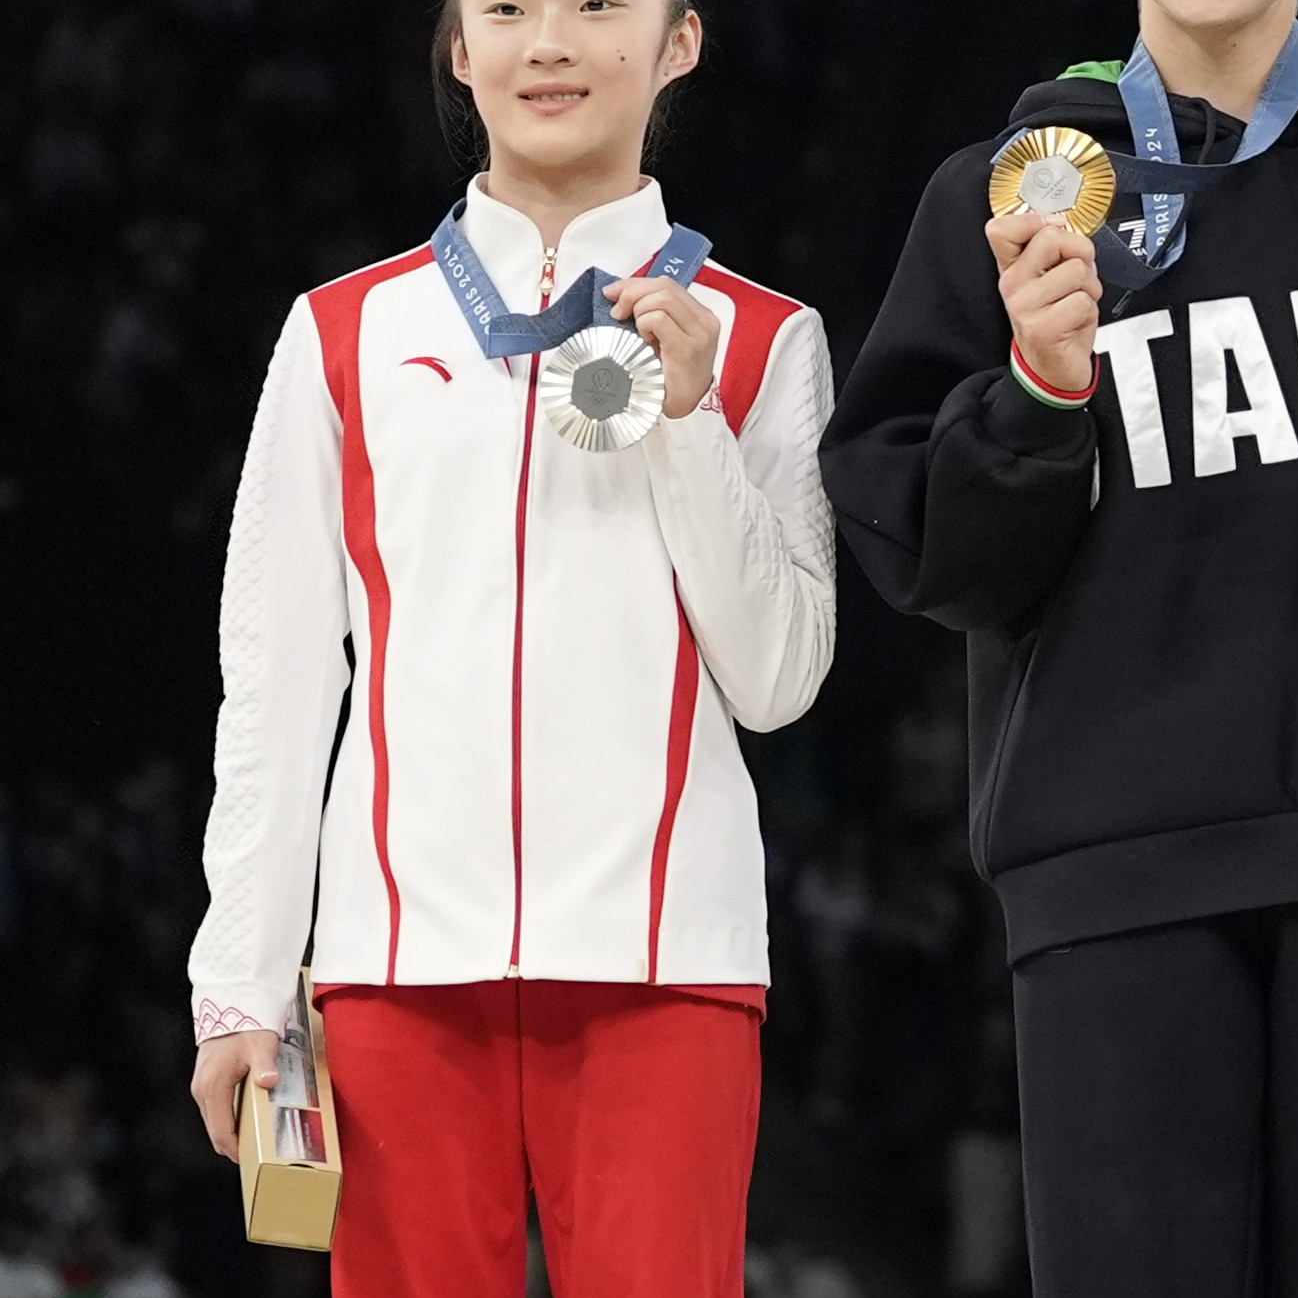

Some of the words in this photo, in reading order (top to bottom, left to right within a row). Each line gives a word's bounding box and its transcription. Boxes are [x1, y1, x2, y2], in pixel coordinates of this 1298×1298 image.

[1145, 128, 1163, 162] 24
[444, 244, 471, 288] 2024
[664, 257, 684, 275] 24
